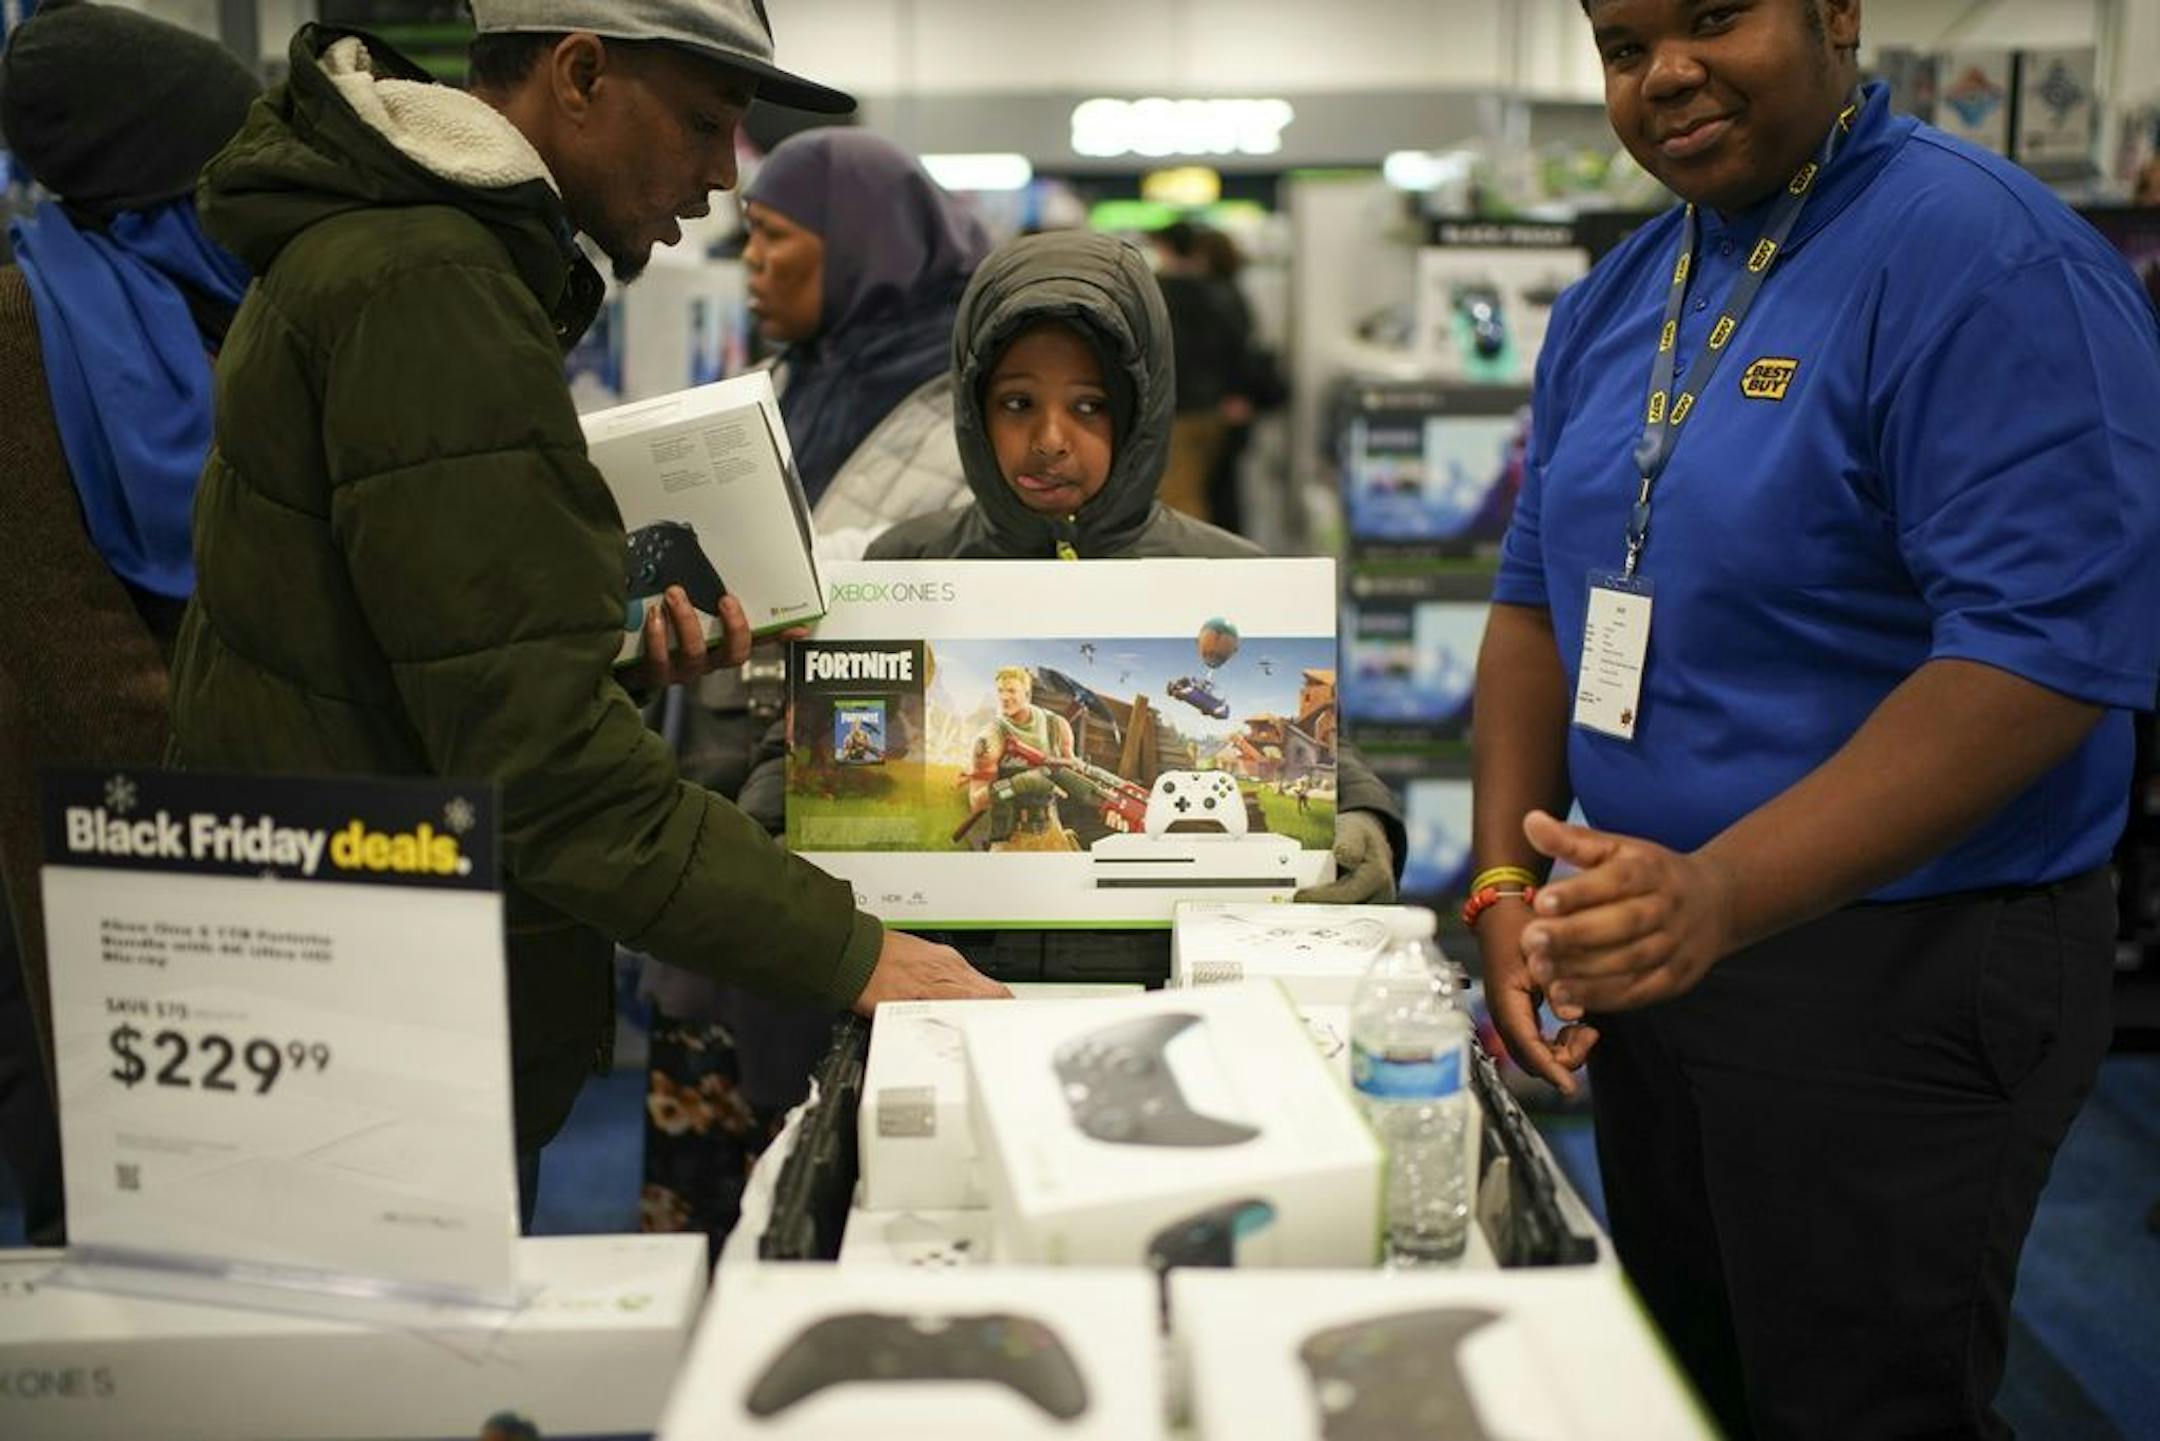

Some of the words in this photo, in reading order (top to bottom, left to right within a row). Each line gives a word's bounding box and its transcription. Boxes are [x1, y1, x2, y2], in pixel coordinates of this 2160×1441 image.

[1752, 365, 1793, 379] BEST
[1748, 379, 1783, 392] BUY
[831, 582, 888, 602] XBOX
[892, 582, 936, 602] ONE
[942, 582, 955, 602] S
[805, 650, 913, 683] FORTNITE
[66, 806, 186, 858] Black
[189, 813, 326, 875] Friday
[330, 819, 472, 877] deals.
[109, 1022, 282, 1095] $229
